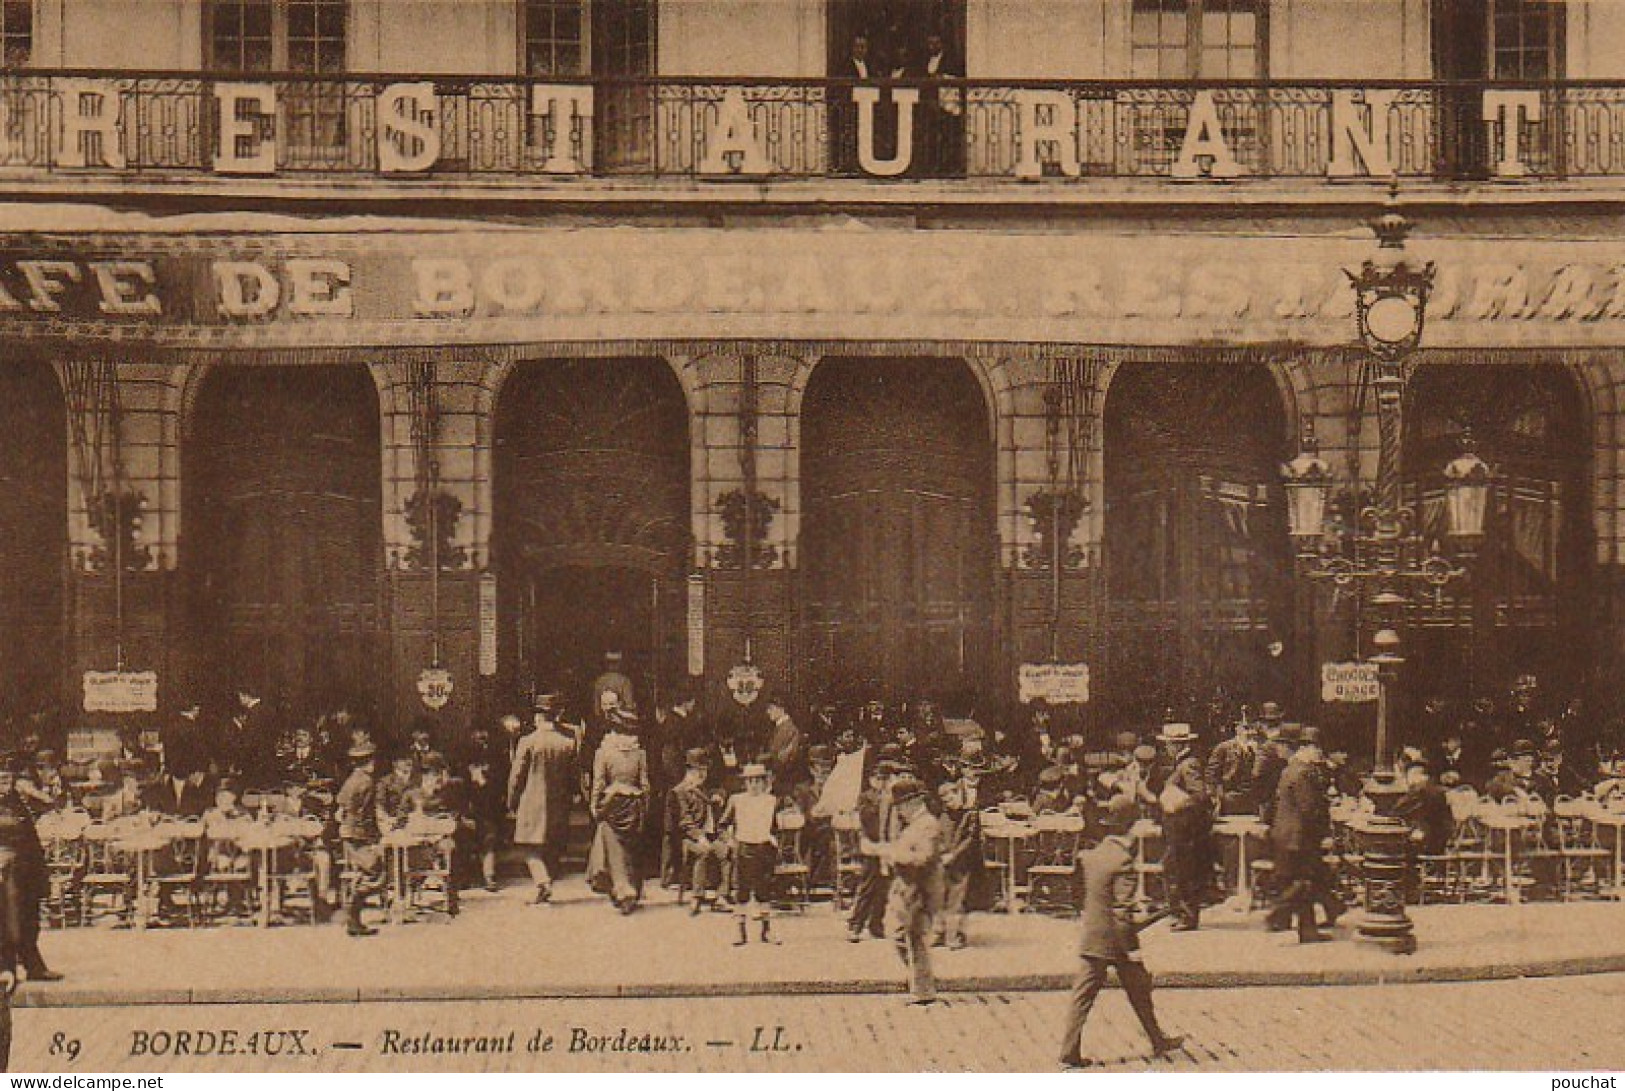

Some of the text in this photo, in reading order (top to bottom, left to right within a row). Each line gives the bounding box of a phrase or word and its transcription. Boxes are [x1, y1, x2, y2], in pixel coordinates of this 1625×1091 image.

[56, 77, 1542, 178] RESTAURANT
[213, 259, 353, 318] DE
[411, 256, 986, 315] BORDEAUX
